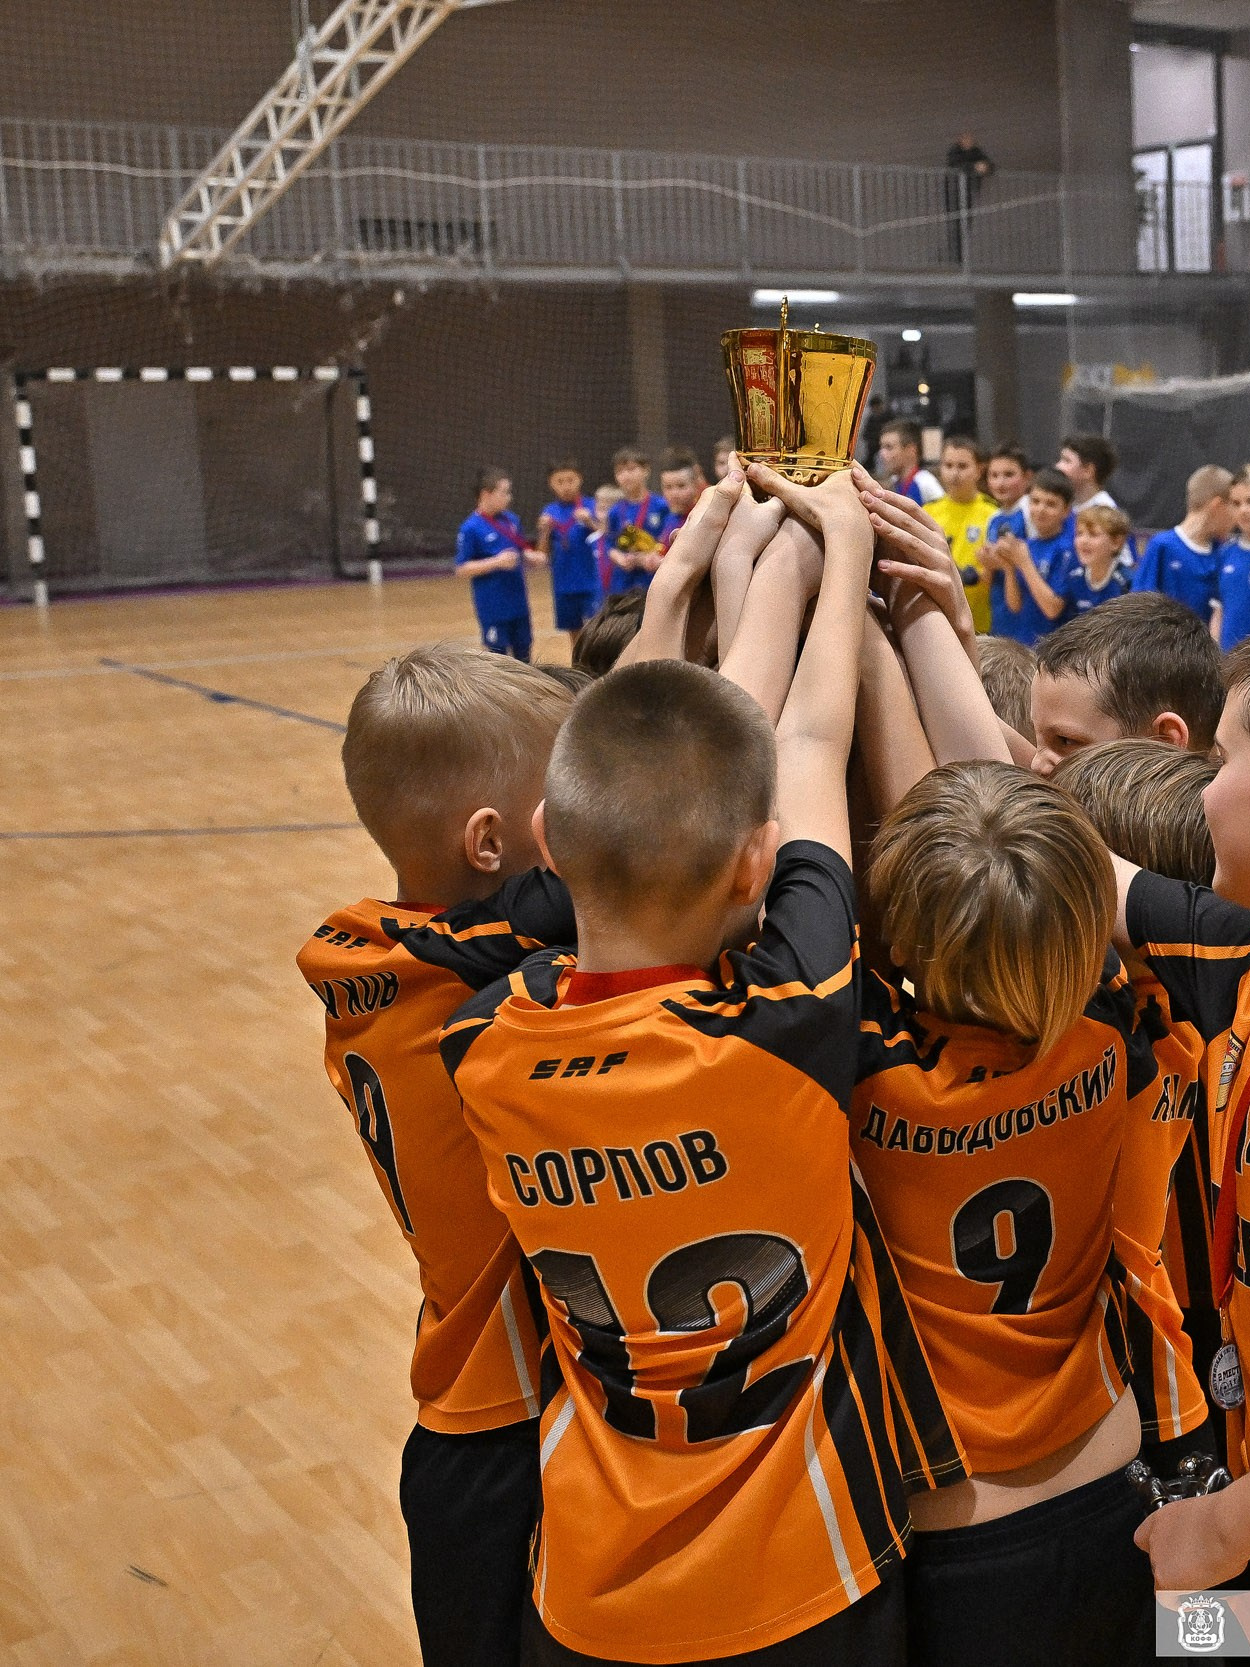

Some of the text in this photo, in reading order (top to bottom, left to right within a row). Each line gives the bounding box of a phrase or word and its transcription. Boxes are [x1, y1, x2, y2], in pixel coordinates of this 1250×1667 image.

[313, 924, 371, 949] SAF
[528, 1050, 629, 1080] SAF
[859, 1043, 1117, 1156] ДАВЫДОВСКИЙ
[505, 1128, 731, 1209] СОРПОВ
[950, 1176, 1056, 1315] 9
[527, 1229, 815, 1445] 12
